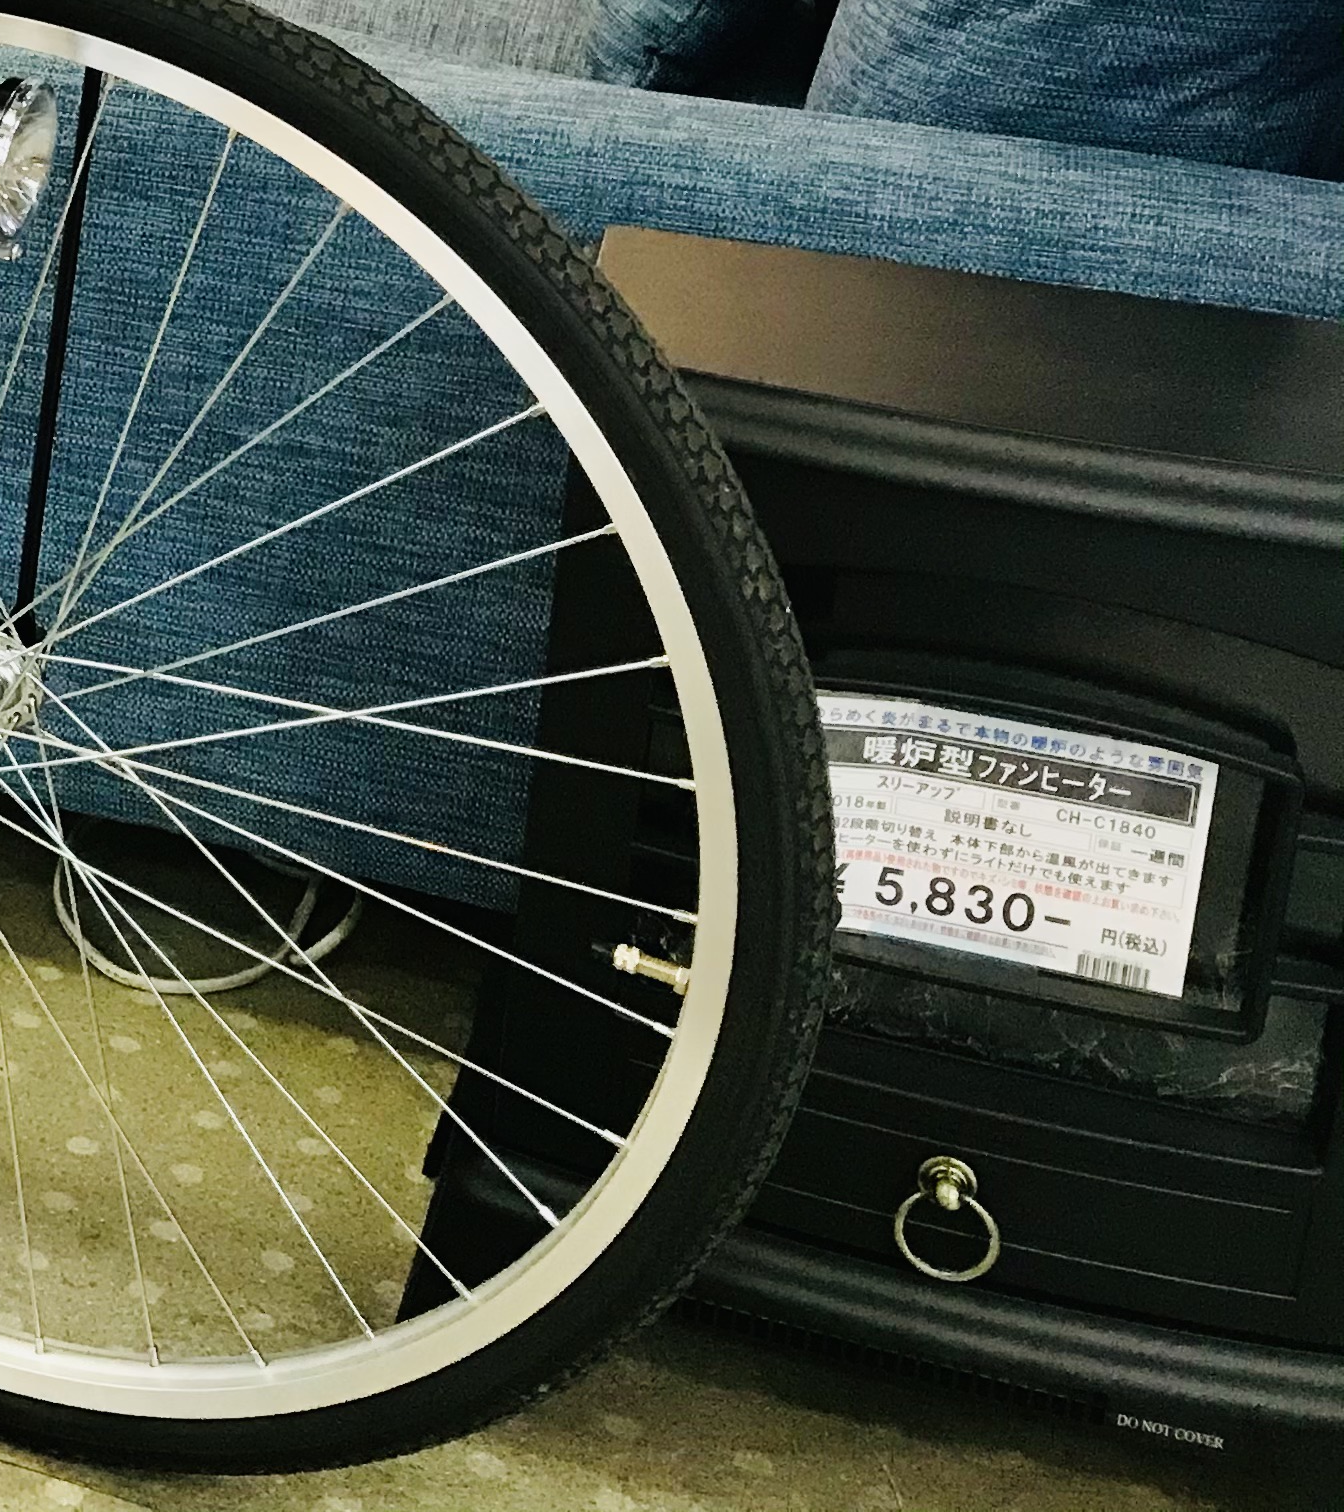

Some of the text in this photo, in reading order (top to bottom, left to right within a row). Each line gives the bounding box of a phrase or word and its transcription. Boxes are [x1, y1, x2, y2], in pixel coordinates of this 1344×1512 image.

[862, 734, 1133, 801] 暖炉型ファンヒーター
[943, 808, 1033, 838] 説明書なし
[1130, 847, 1186, 869] 一週間
[1056, 808, 1157, 840] CH-C1840
[838, 833, 1132, 895] ヒーターを使わずにライトだけでも使えます
[950, 833, 1174, 888] 本体下部から温風が出てきます
[874, 866, 1072, 934] 5,830-
[1100, 927, 1168, 957] 円(税込)
[1116, 1413, 1225, 1450] DO NOT COVER
